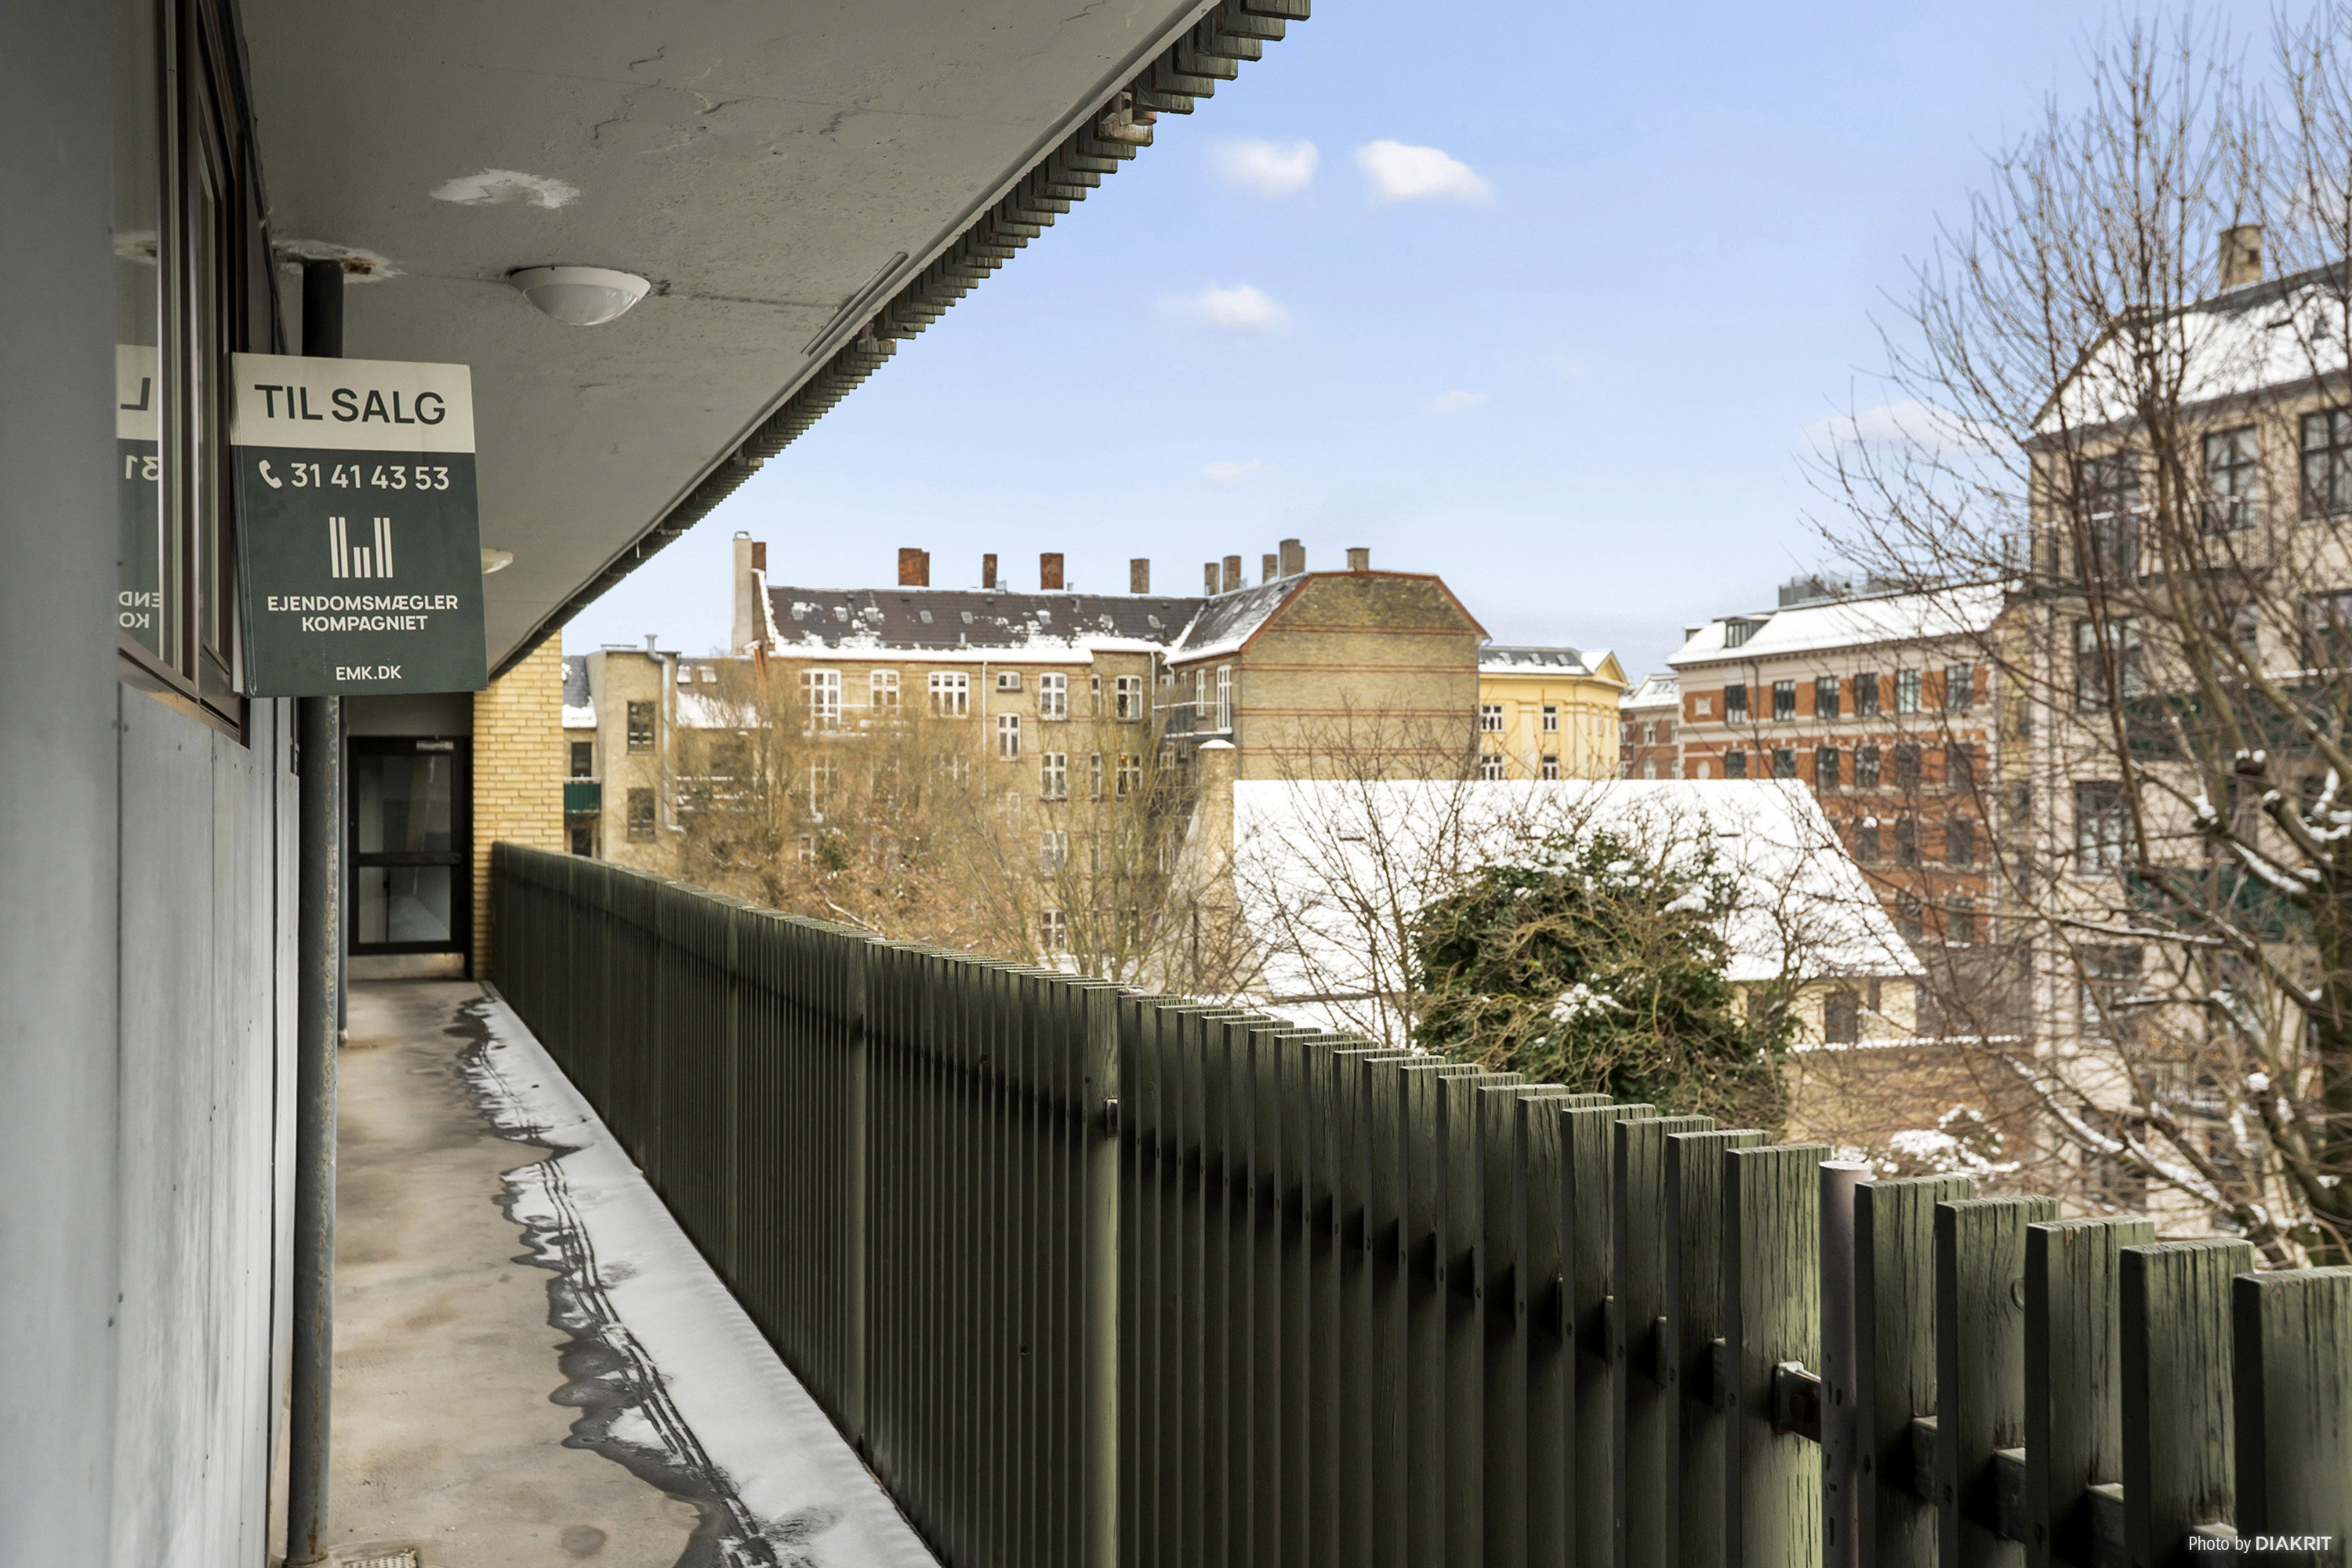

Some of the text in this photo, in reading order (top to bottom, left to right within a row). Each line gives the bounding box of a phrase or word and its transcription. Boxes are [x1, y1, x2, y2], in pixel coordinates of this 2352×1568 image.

[254, 384, 446, 425] TIL SALG
[290, 463, 449, 490] 31 41 43 53
[267, 595, 458, 612] EJENDOMSMÆGLER
[302, 615, 428, 632] KOMPAGNIET
[336, 666, 402, 681] EMK.DK
